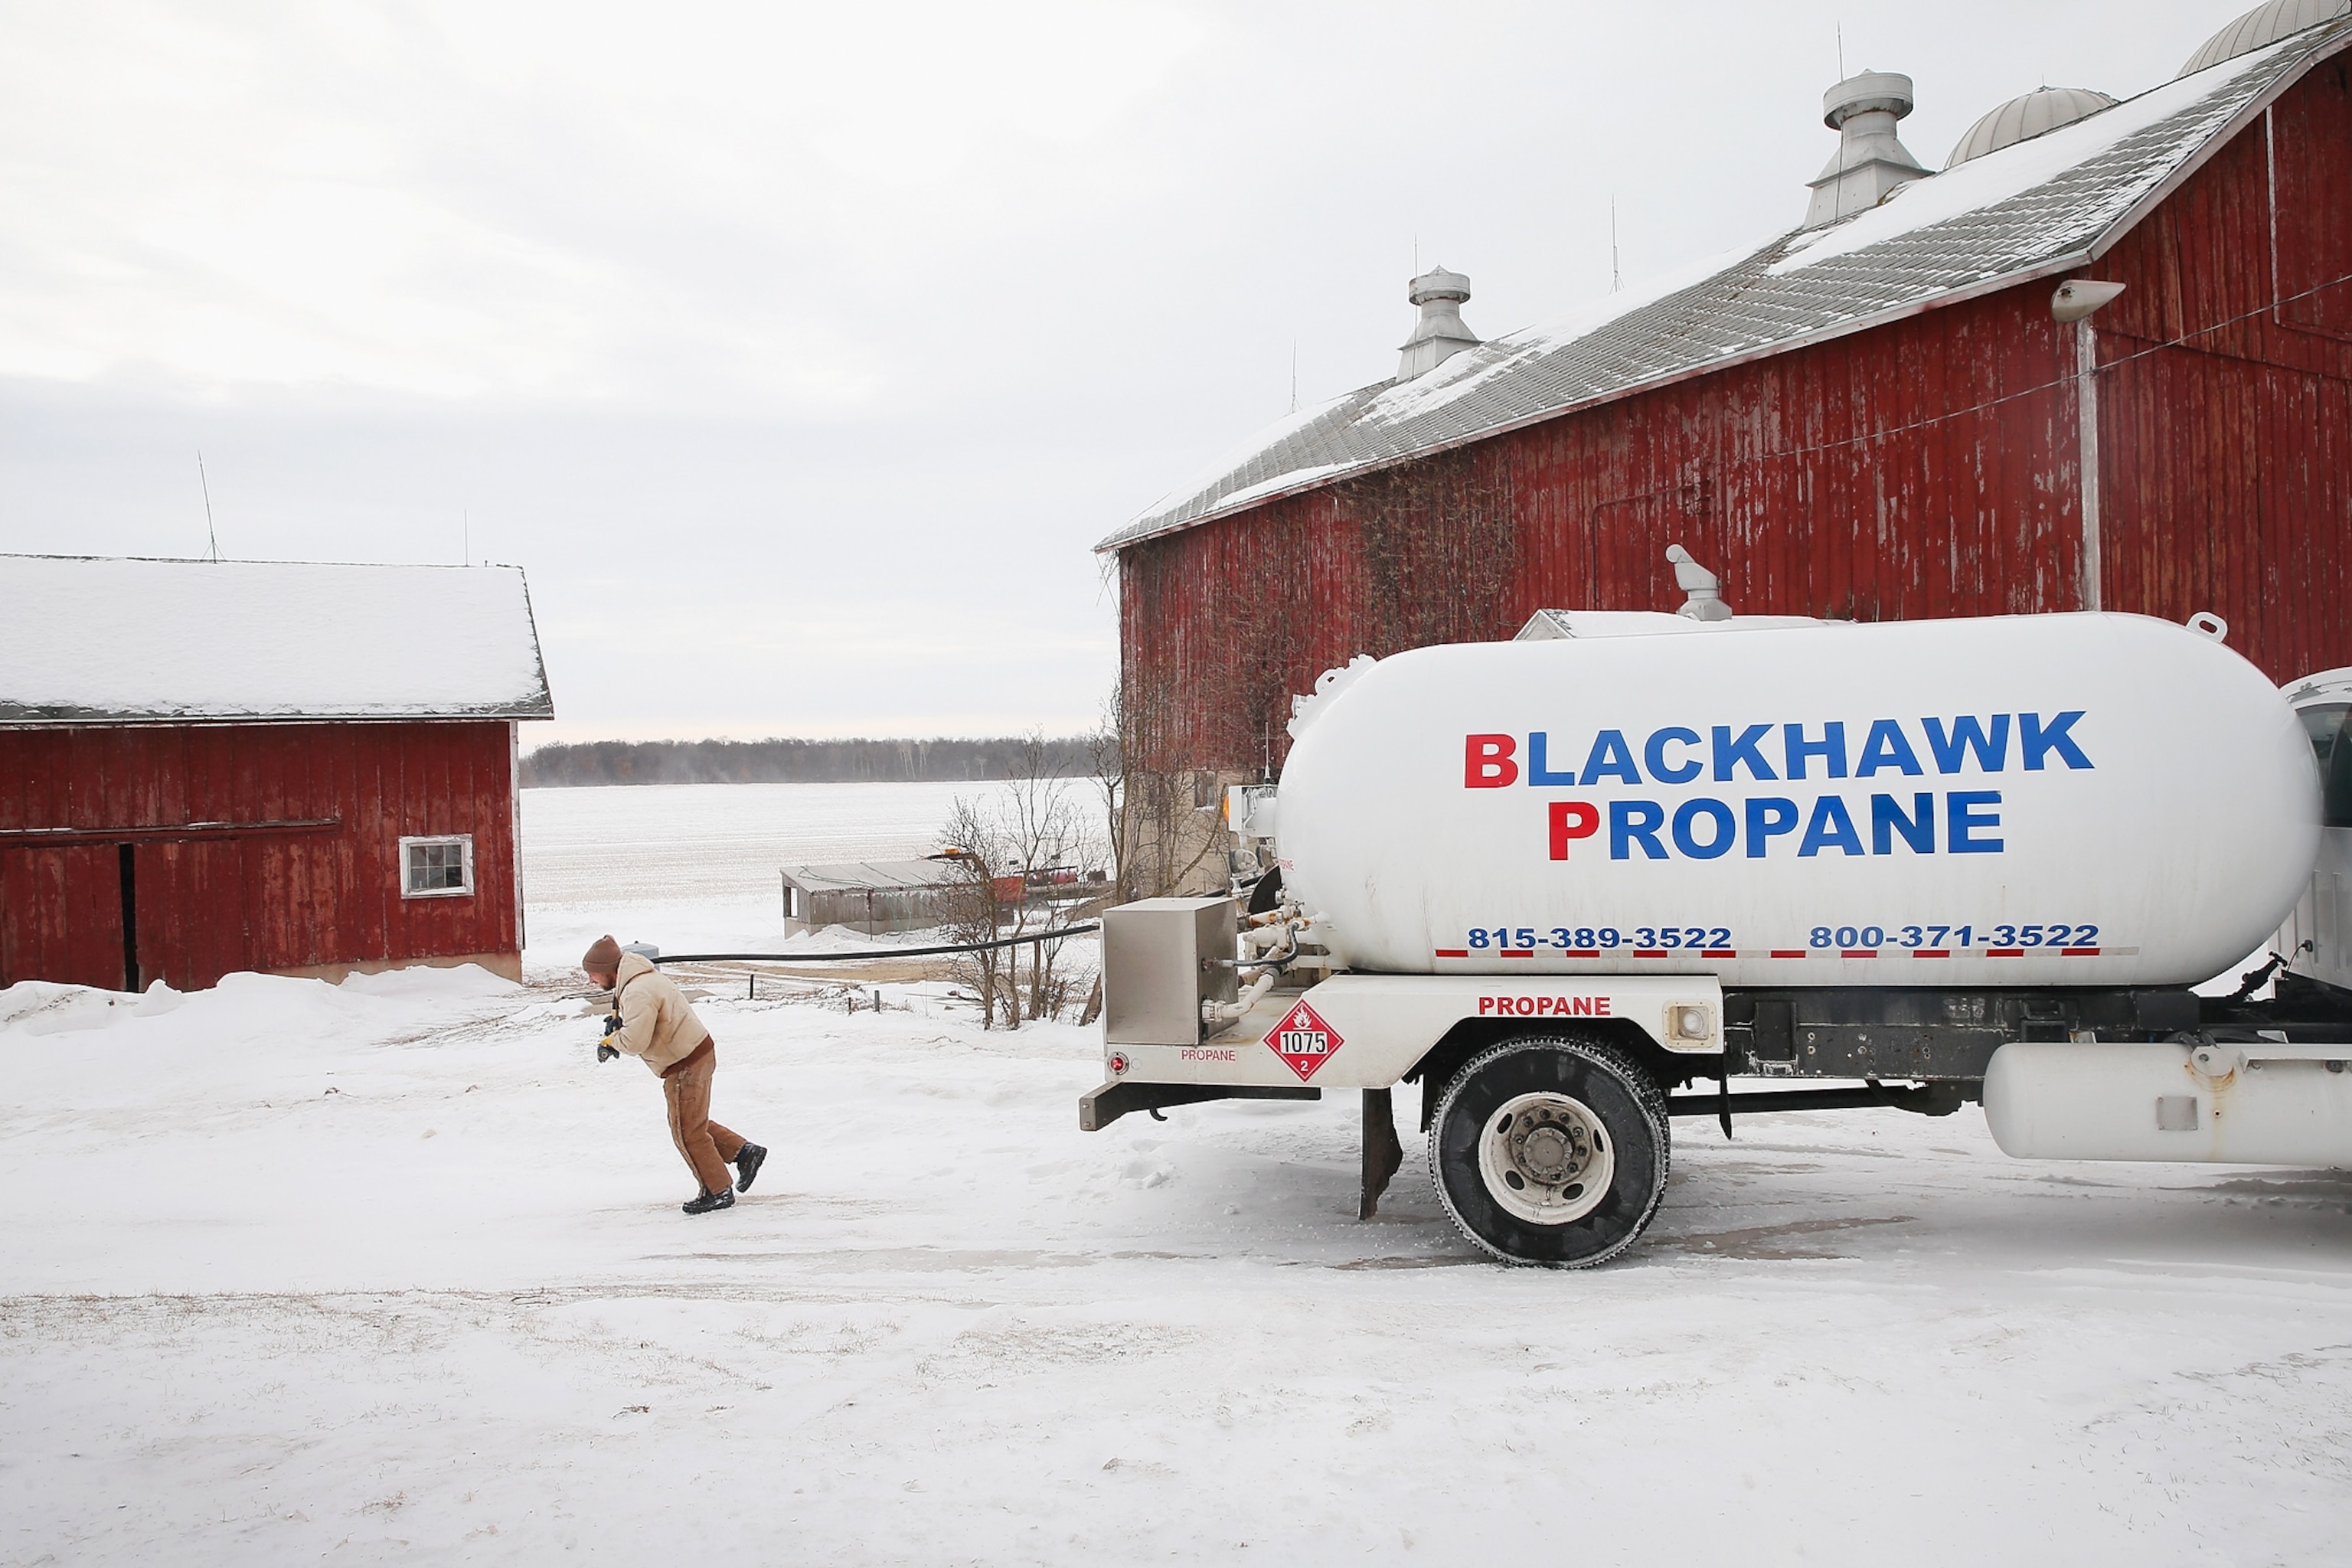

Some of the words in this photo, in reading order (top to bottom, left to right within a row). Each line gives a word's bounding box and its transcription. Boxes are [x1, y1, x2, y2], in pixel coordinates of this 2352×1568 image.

[1465, 711, 2093, 788] BLACKHAWK
[1548, 791, 2004, 861] PROPANE
[1468, 927, 1731, 949] 815-389-3522
[1810, 925, 2099, 948] 800-371-3522
[1478, 997, 1611, 1016] PROPANE
[1282, 1033, 1325, 1052] 1075
[1181, 1049, 1236, 1061] PROPANE
[1300, 1060, 1308, 1071] 2
